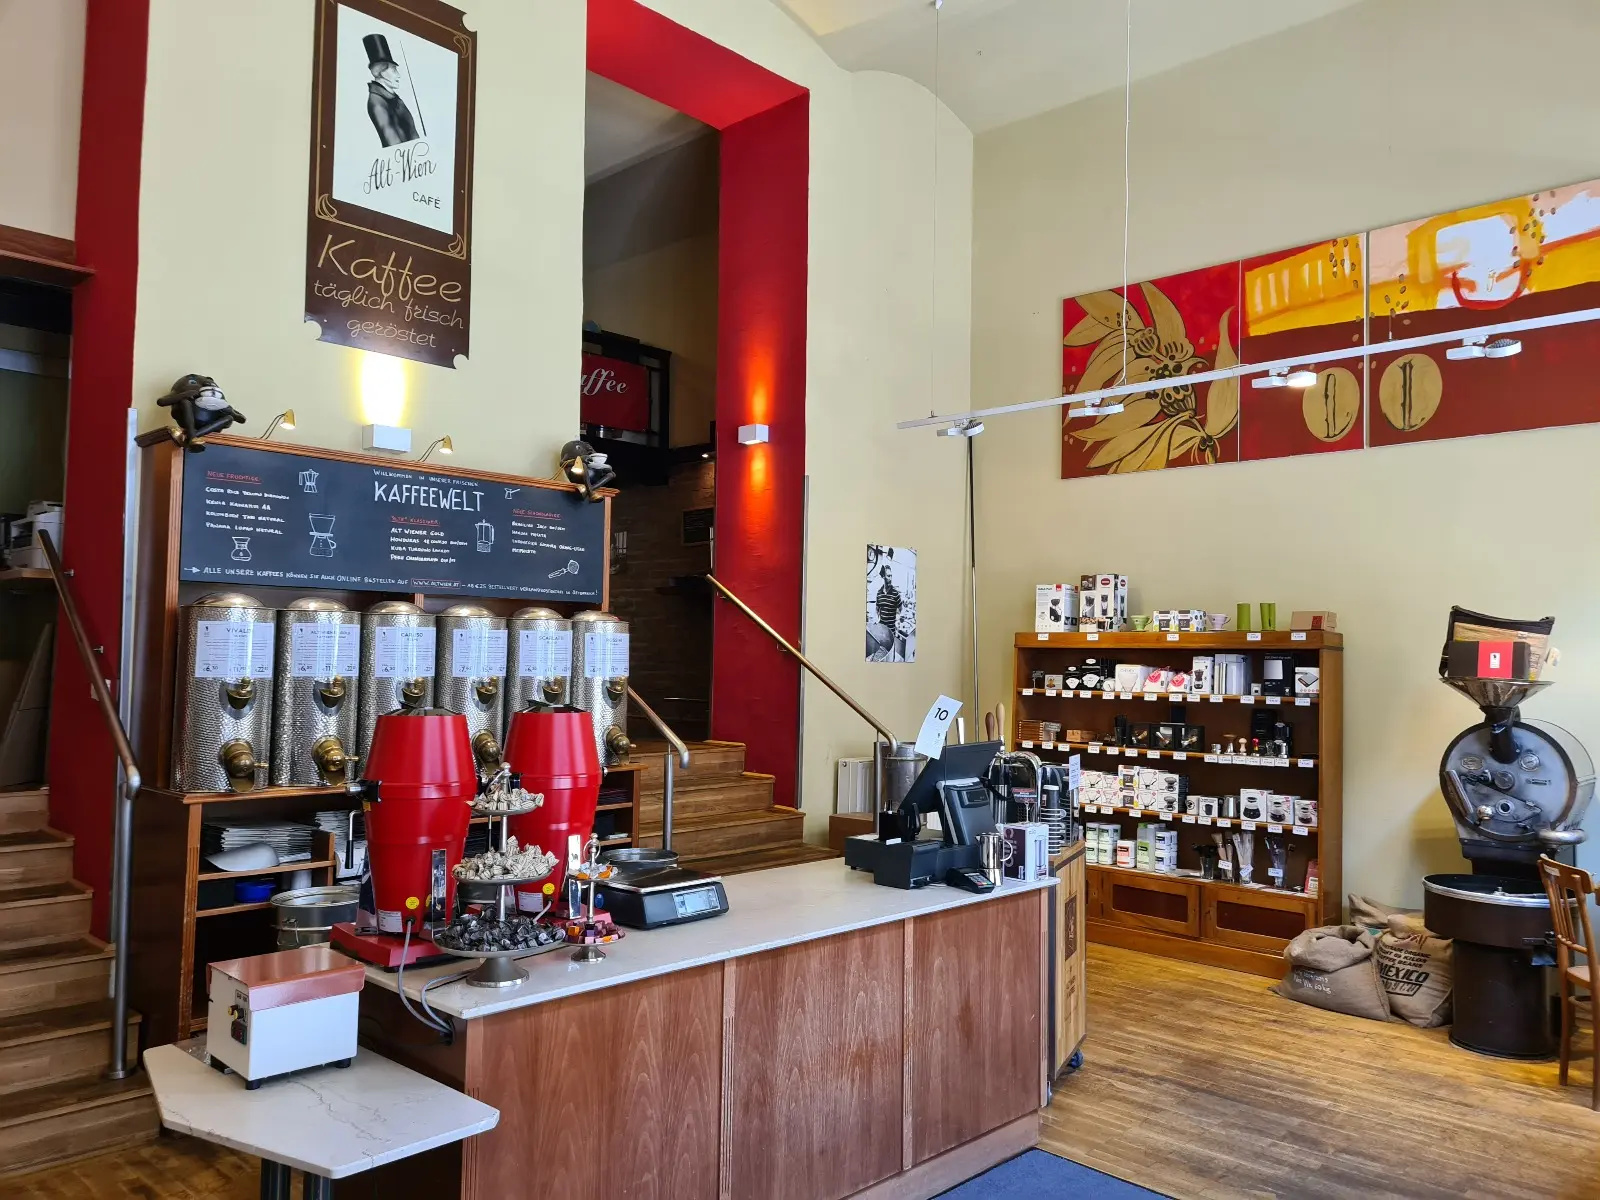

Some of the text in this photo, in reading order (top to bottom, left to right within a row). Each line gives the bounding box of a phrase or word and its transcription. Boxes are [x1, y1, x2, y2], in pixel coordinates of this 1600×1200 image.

[363, 142, 437, 194] Alt-Wien
[317, 234, 462, 302] Kaffee
[314, 279, 463, 329] täglich frisch
[346, 319, 437, 348] geröstet
[373, 468, 413, 479] WILLKOMMEN
[428, 476, 452, 484] UNSERER
[452, 479, 479, 487] FRISCHEN
[374, 480, 485, 512] KAFFEEWELT
[390, 536, 420, 544] HONDURAS
[225, 568, 254, 576] UNSERE
[364, 576, 396, 584] BESTELLEN
[934, 707, 949, 721] 10
